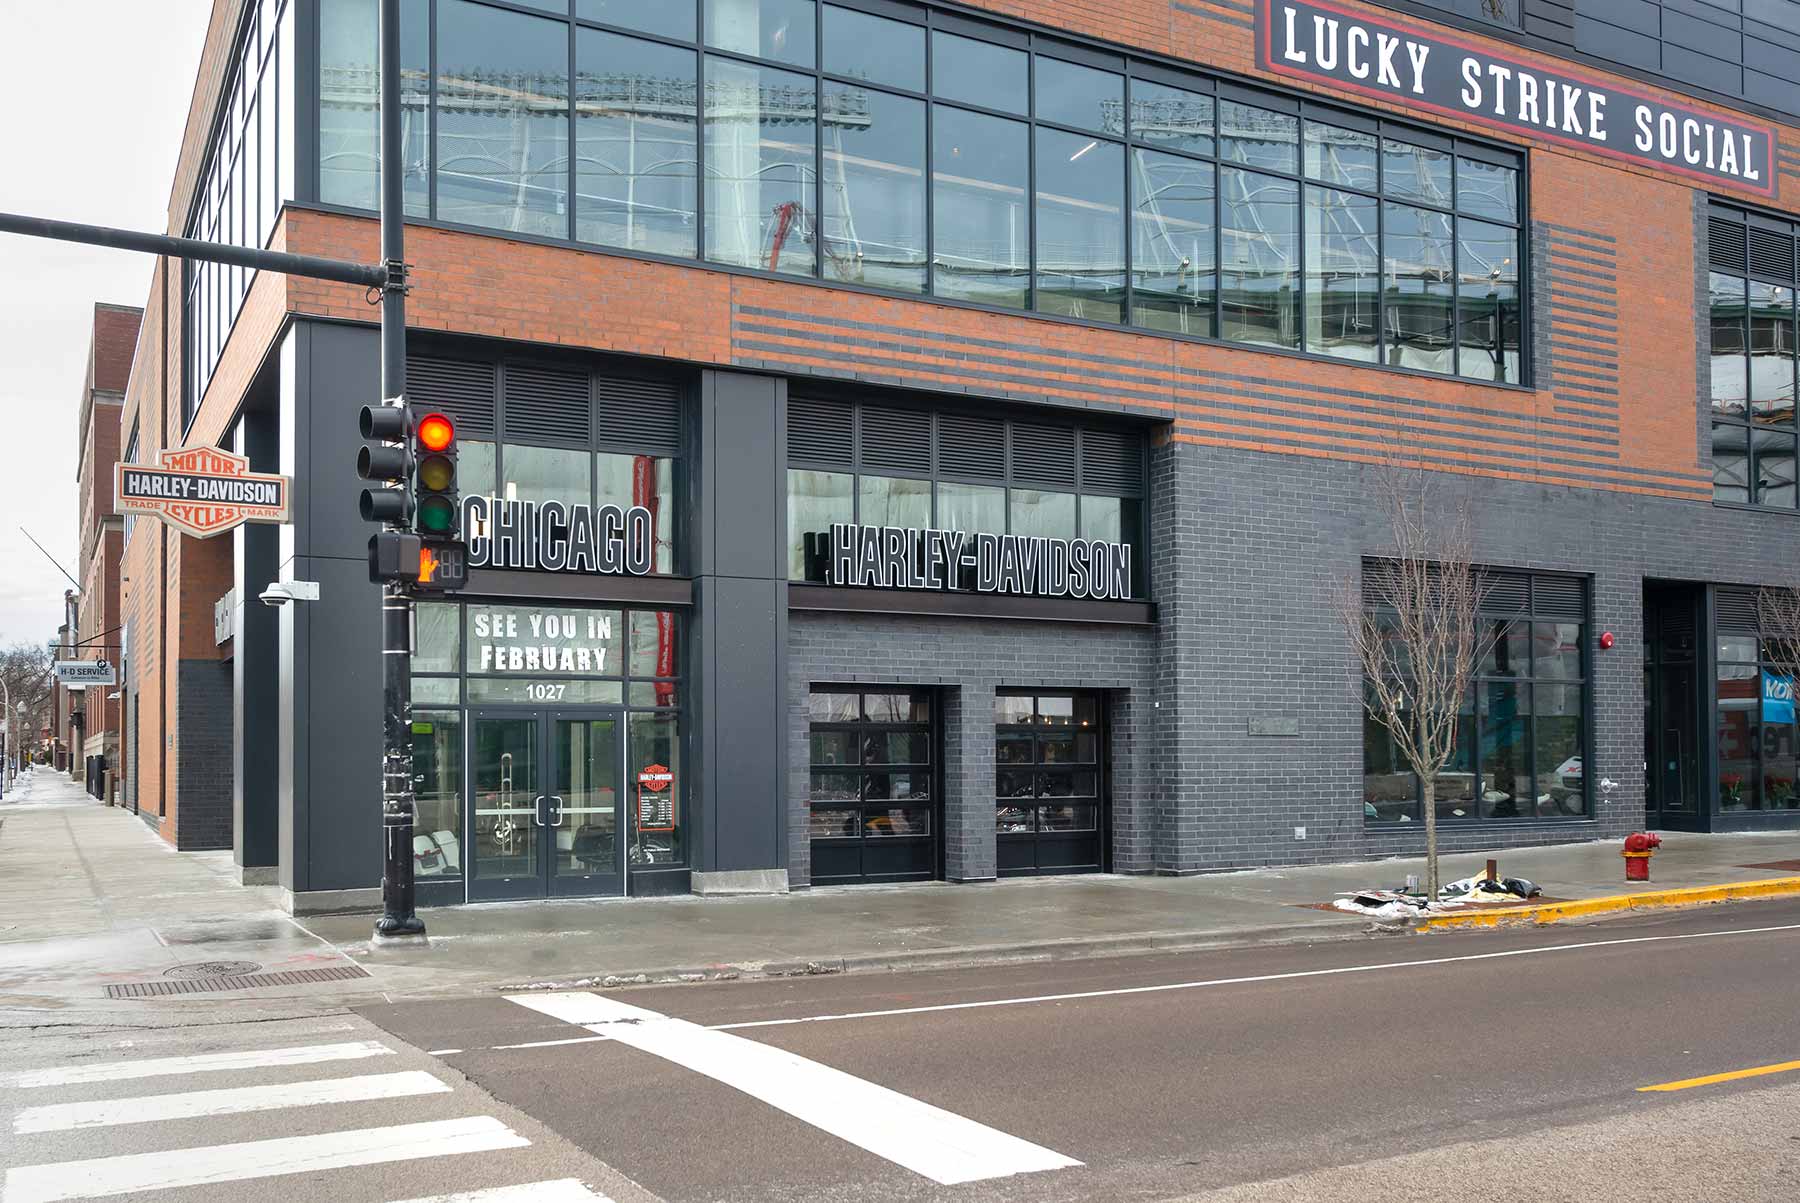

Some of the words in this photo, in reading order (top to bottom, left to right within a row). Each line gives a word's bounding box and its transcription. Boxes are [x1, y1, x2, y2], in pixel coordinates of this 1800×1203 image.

[1283, 6, 1430, 95] LUCKY
[1461, 56, 1607, 141] STRIKE
[1634, 105, 1759, 181] SOCIAL
[171, 451, 235, 473] MOTOR
[128, 473, 276, 504] HARLEY-DAVIDSON
[124, 500, 161, 510] TRADE
[171, 504, 234, 527] CYCLES
[247, 508, 280, 518] MARK
[461, 494, 652, 576] CHICAGO
[833, 523, 1131, 600] HARLEY-DAVIDSON
[474, 613, 518, 638] SEE
[529, 614, 576, 638] YOU
[587, 615, 612, 640] IN
[480, 644, 607, 671] FEBRUARY
[526, 683, 566, 700] 1027
